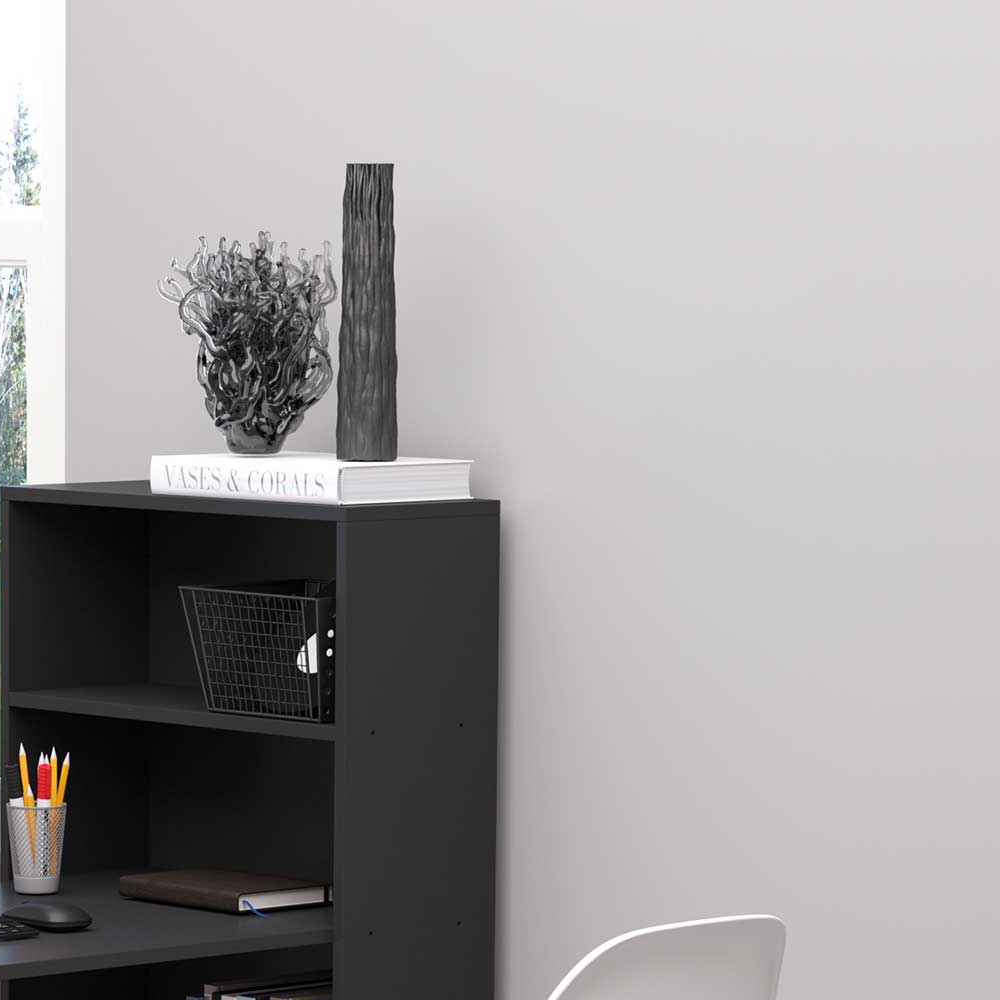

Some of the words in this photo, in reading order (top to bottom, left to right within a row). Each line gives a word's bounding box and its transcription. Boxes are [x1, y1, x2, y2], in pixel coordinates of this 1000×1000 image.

[165, 464, 221, 490] VASES
[226, 469, 240, 493] &
[248, 470, 325, 497] CORALS
